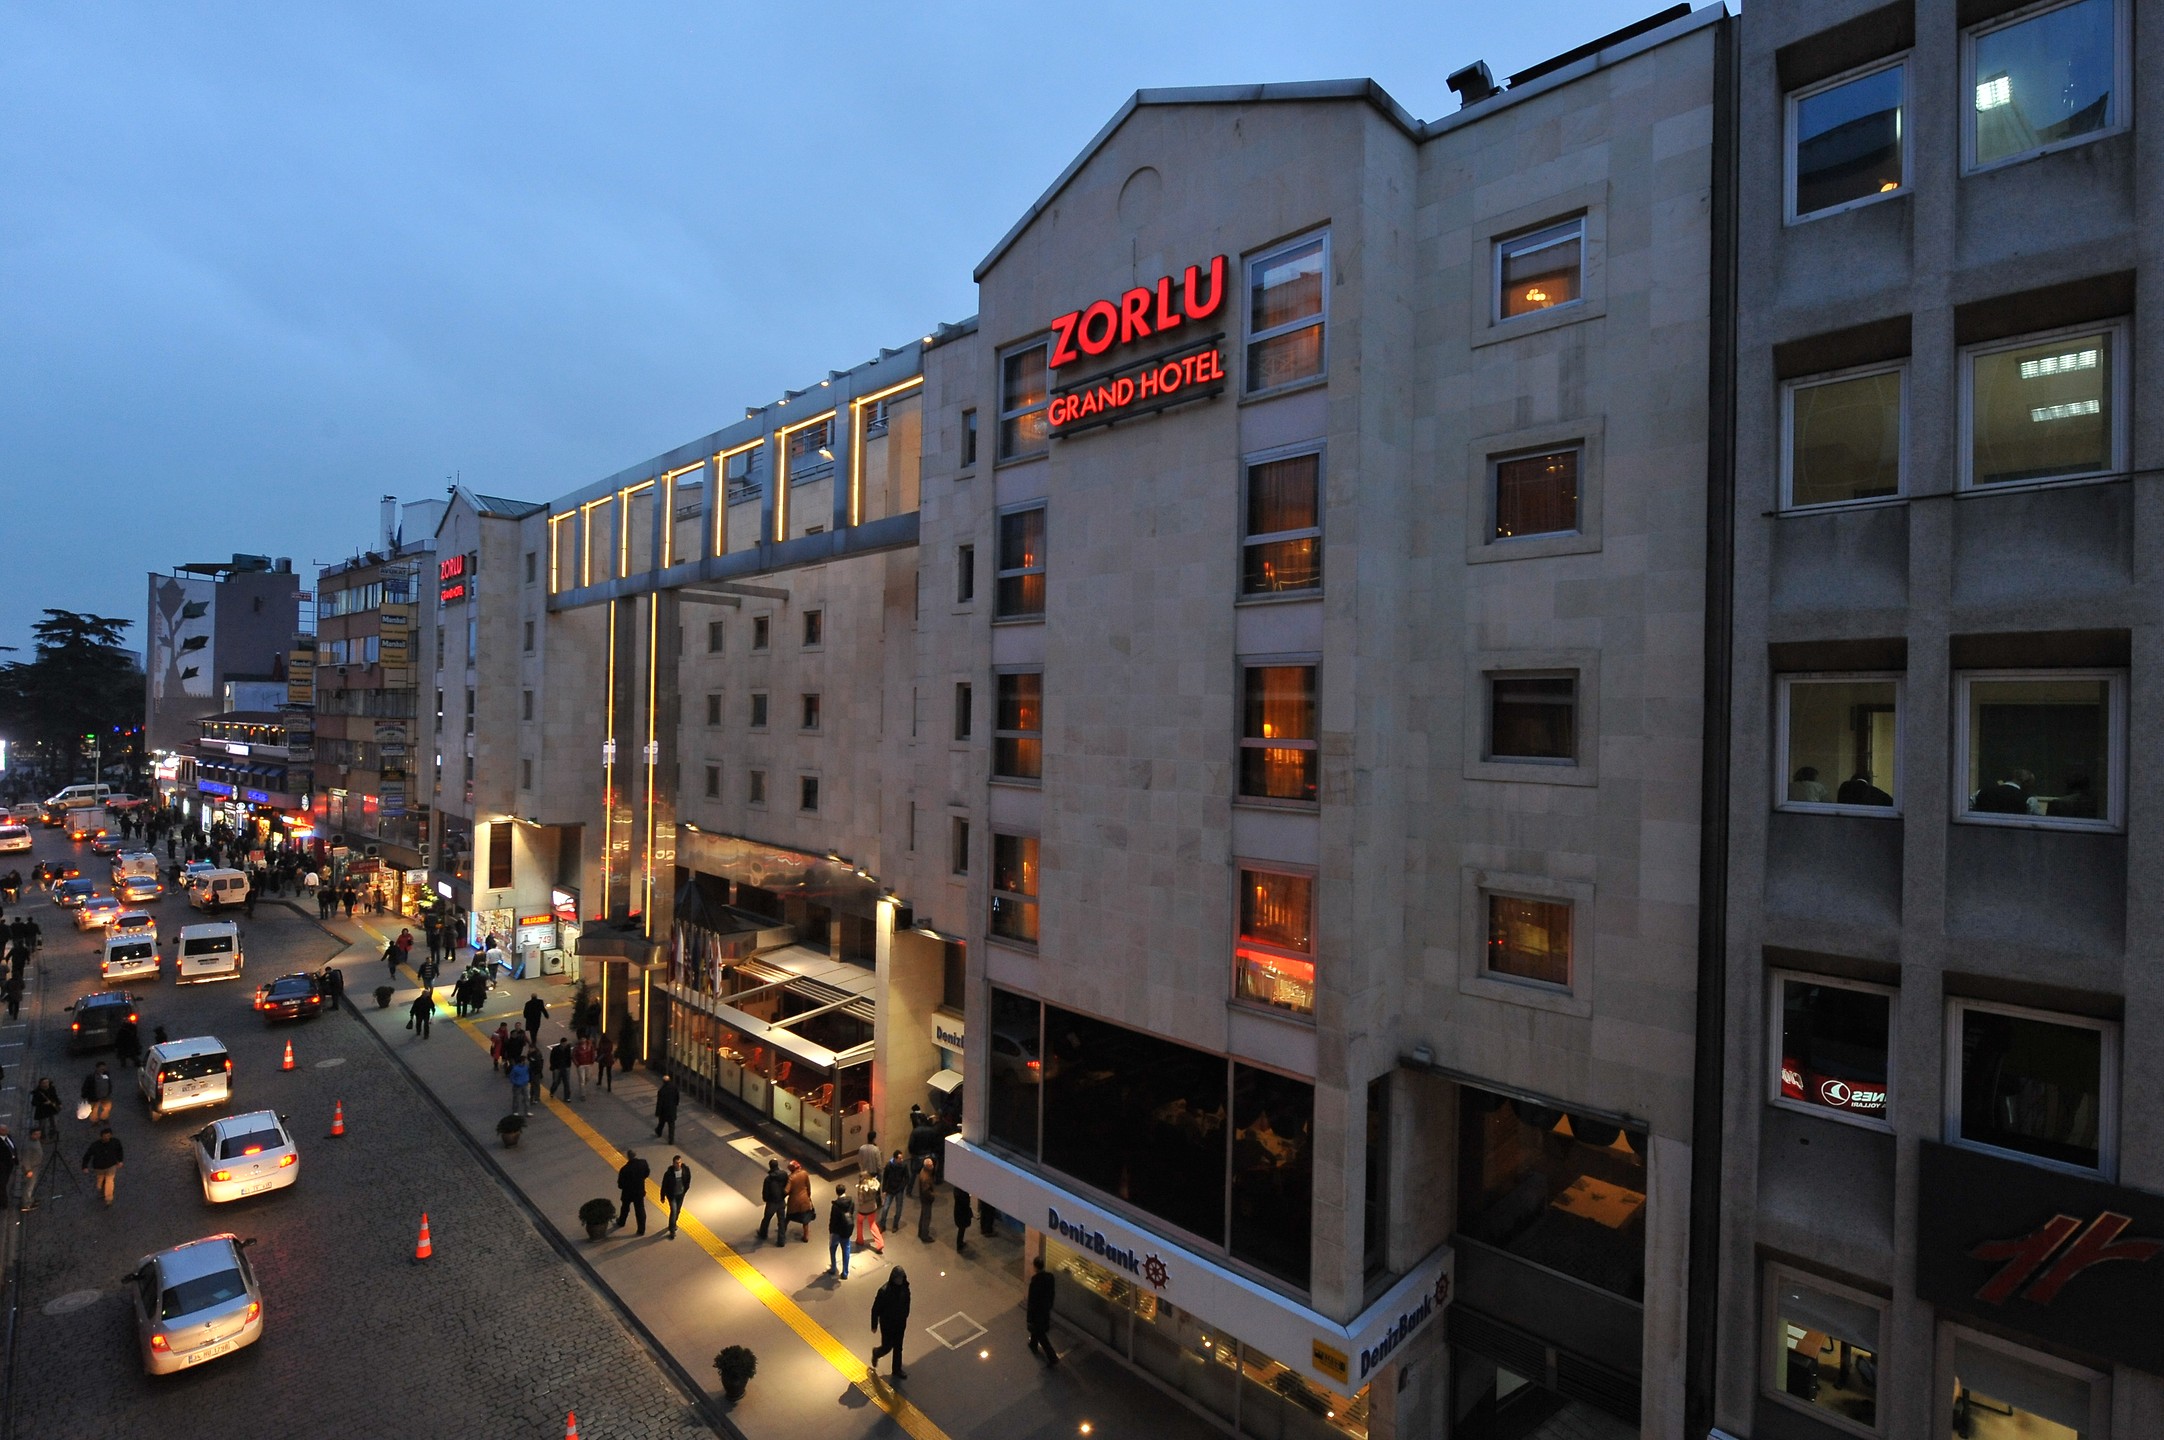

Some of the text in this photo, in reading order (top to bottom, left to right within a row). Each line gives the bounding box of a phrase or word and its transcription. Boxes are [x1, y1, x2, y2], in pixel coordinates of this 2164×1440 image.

[1049, 254, 1228, 369] ZORLU
[1048, 349, 1225, 427] GRAND HOTEL
[440, 554, 463, 580] ZORLU
[1048, 1207, 1140, 1276] DenizBank
[1361, 1294, 1432, 1379] DenizBank
